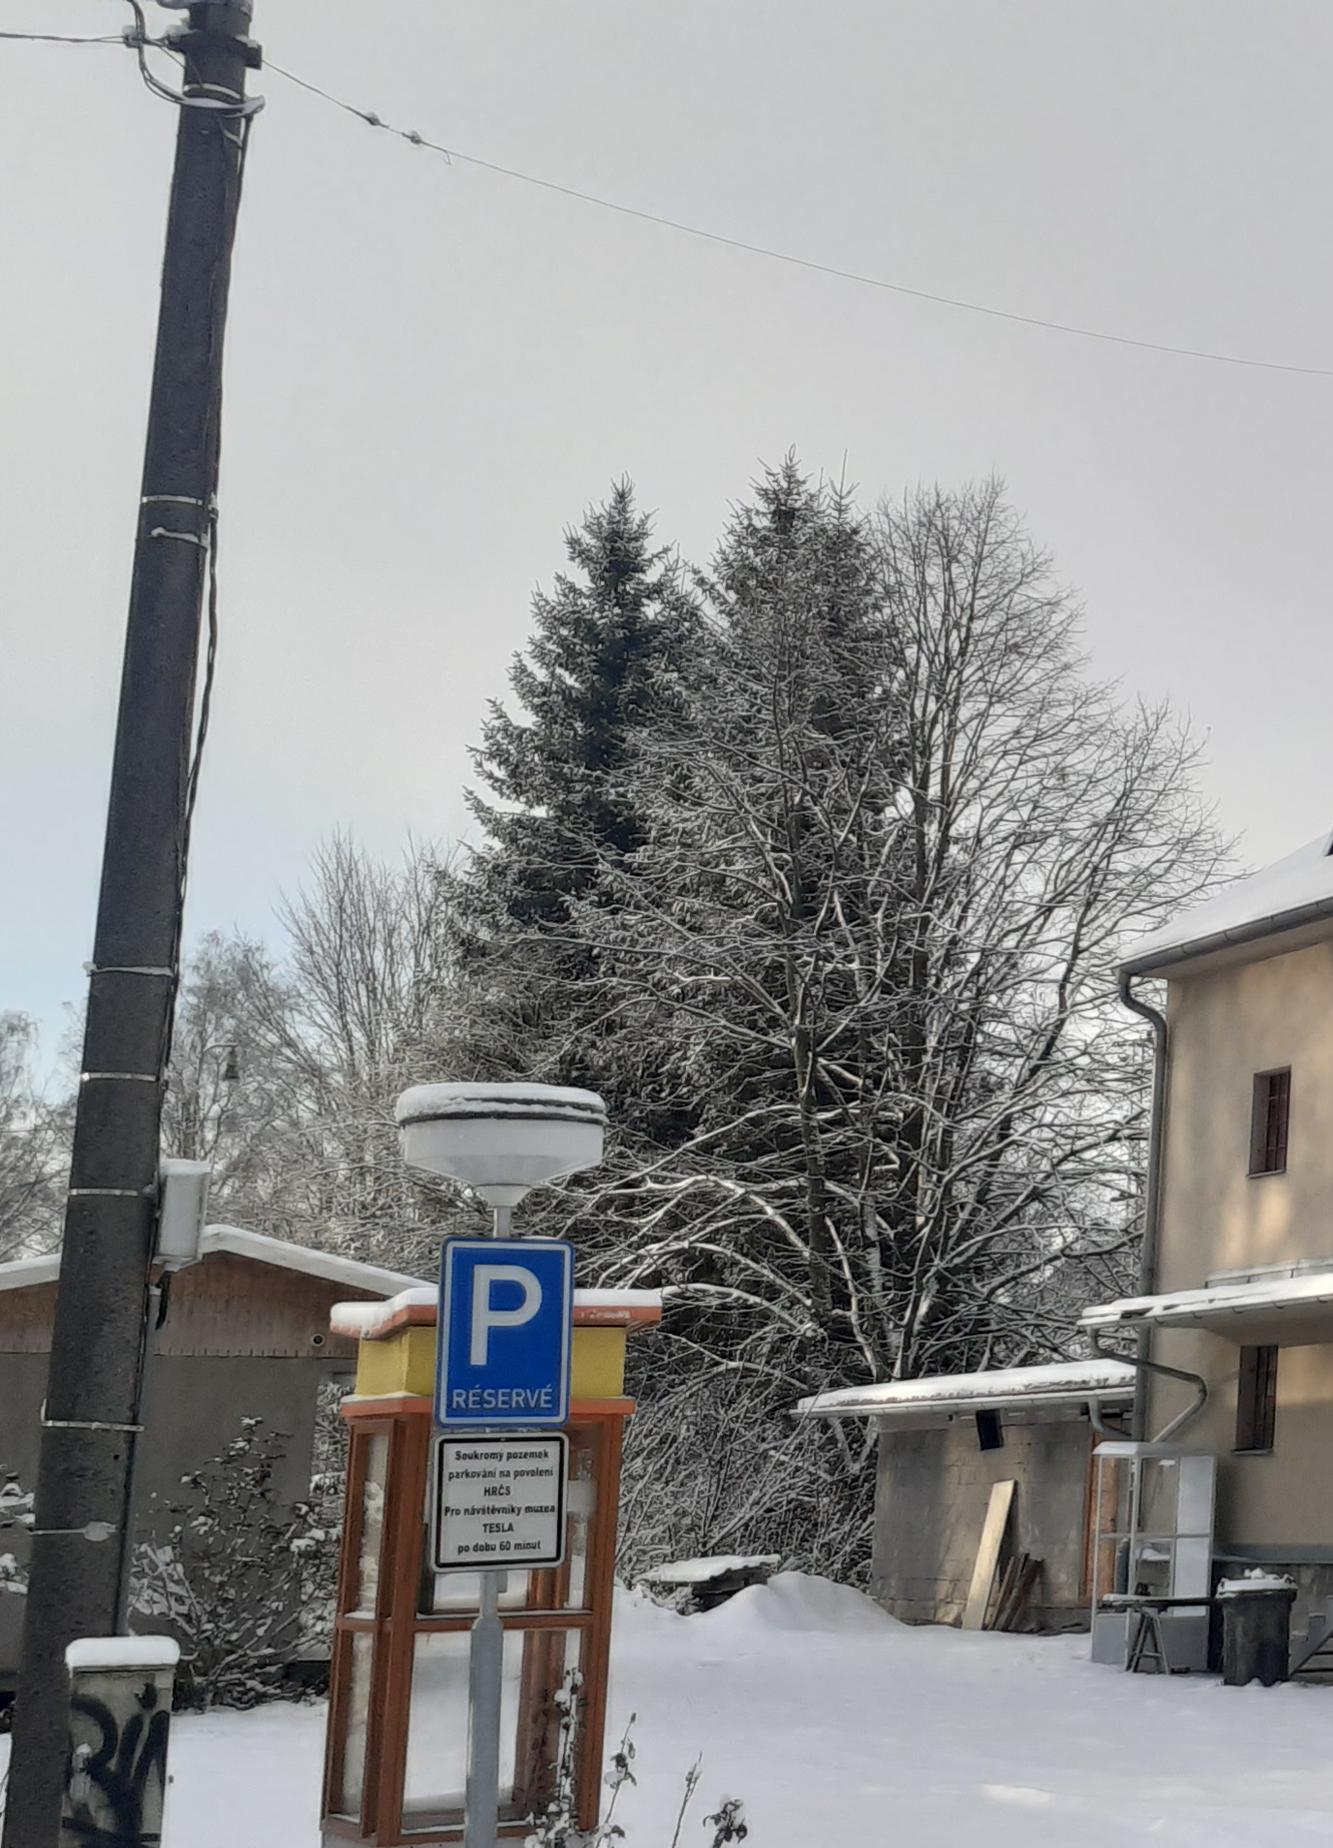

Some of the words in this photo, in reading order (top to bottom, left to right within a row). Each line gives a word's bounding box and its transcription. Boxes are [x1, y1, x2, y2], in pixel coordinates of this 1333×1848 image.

[470, 1263, 543, 1366] P
[451, 1384, 553, 1410] RÉSERVÉ
[455, 1449, 503, 1461] Soukromý
[506, 1449, 549, 1461] pozemek
[448, 1468, 497, 1482] parkování
[499, 1470, 512, 1478] na
[483, 1484, 512, 1497] HRČS
[444, 1506, 461, 1517] Pro
[524, 1505, 556, 1514] muzea
[482, 1523, 515, 1533] TESLA
[457, 1544, 470, 1555] po
[472, 1541, 497, 1552] dobu
[499, 1541, 512, 1551] 60
[514, 1540, 542, 1551] minut
